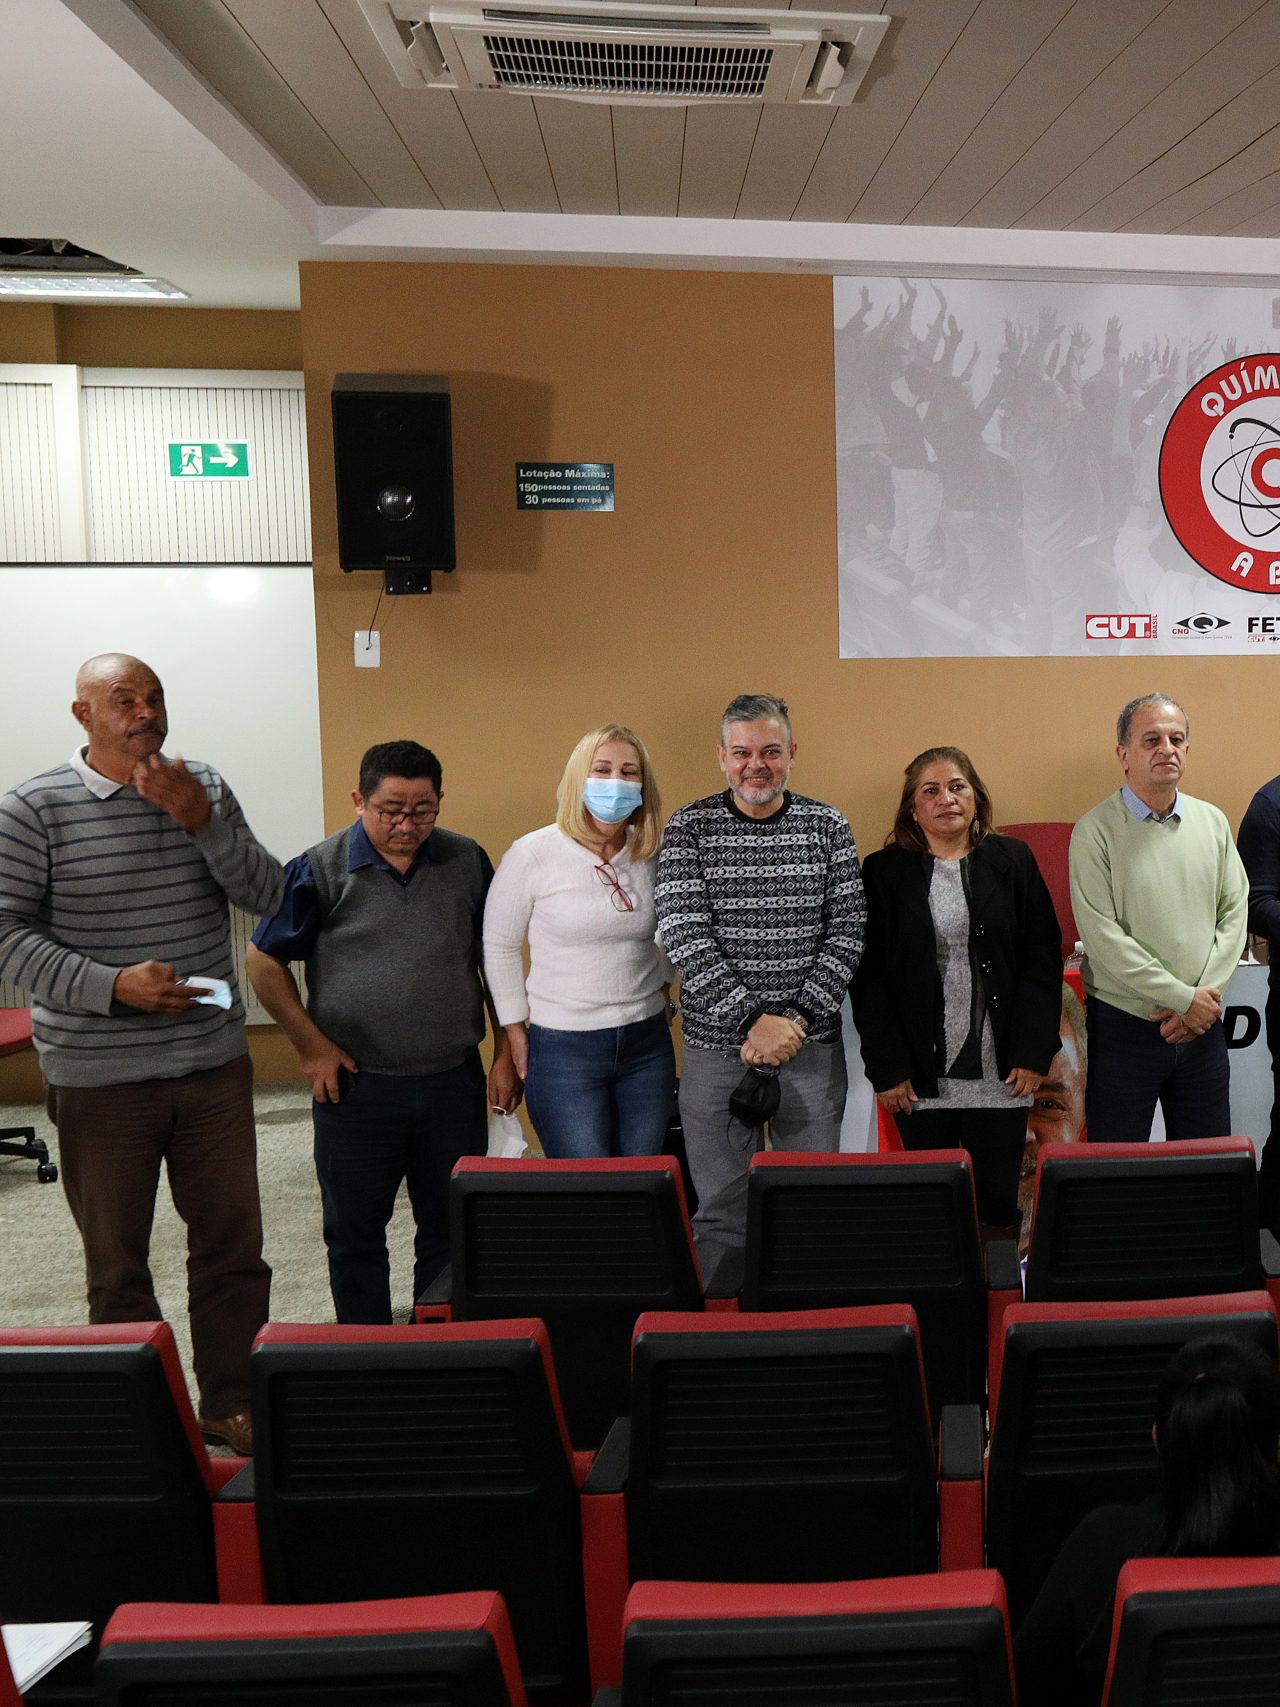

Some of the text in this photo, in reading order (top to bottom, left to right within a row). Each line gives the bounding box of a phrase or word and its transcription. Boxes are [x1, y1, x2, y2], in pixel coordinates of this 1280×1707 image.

[519, 468, 610, 479] Lotação Máxima:
[525, 494, 539, 505] 30
[1086, 616, 1150, 638] CUT
[1172, 628, 1190, 636] CNQ
